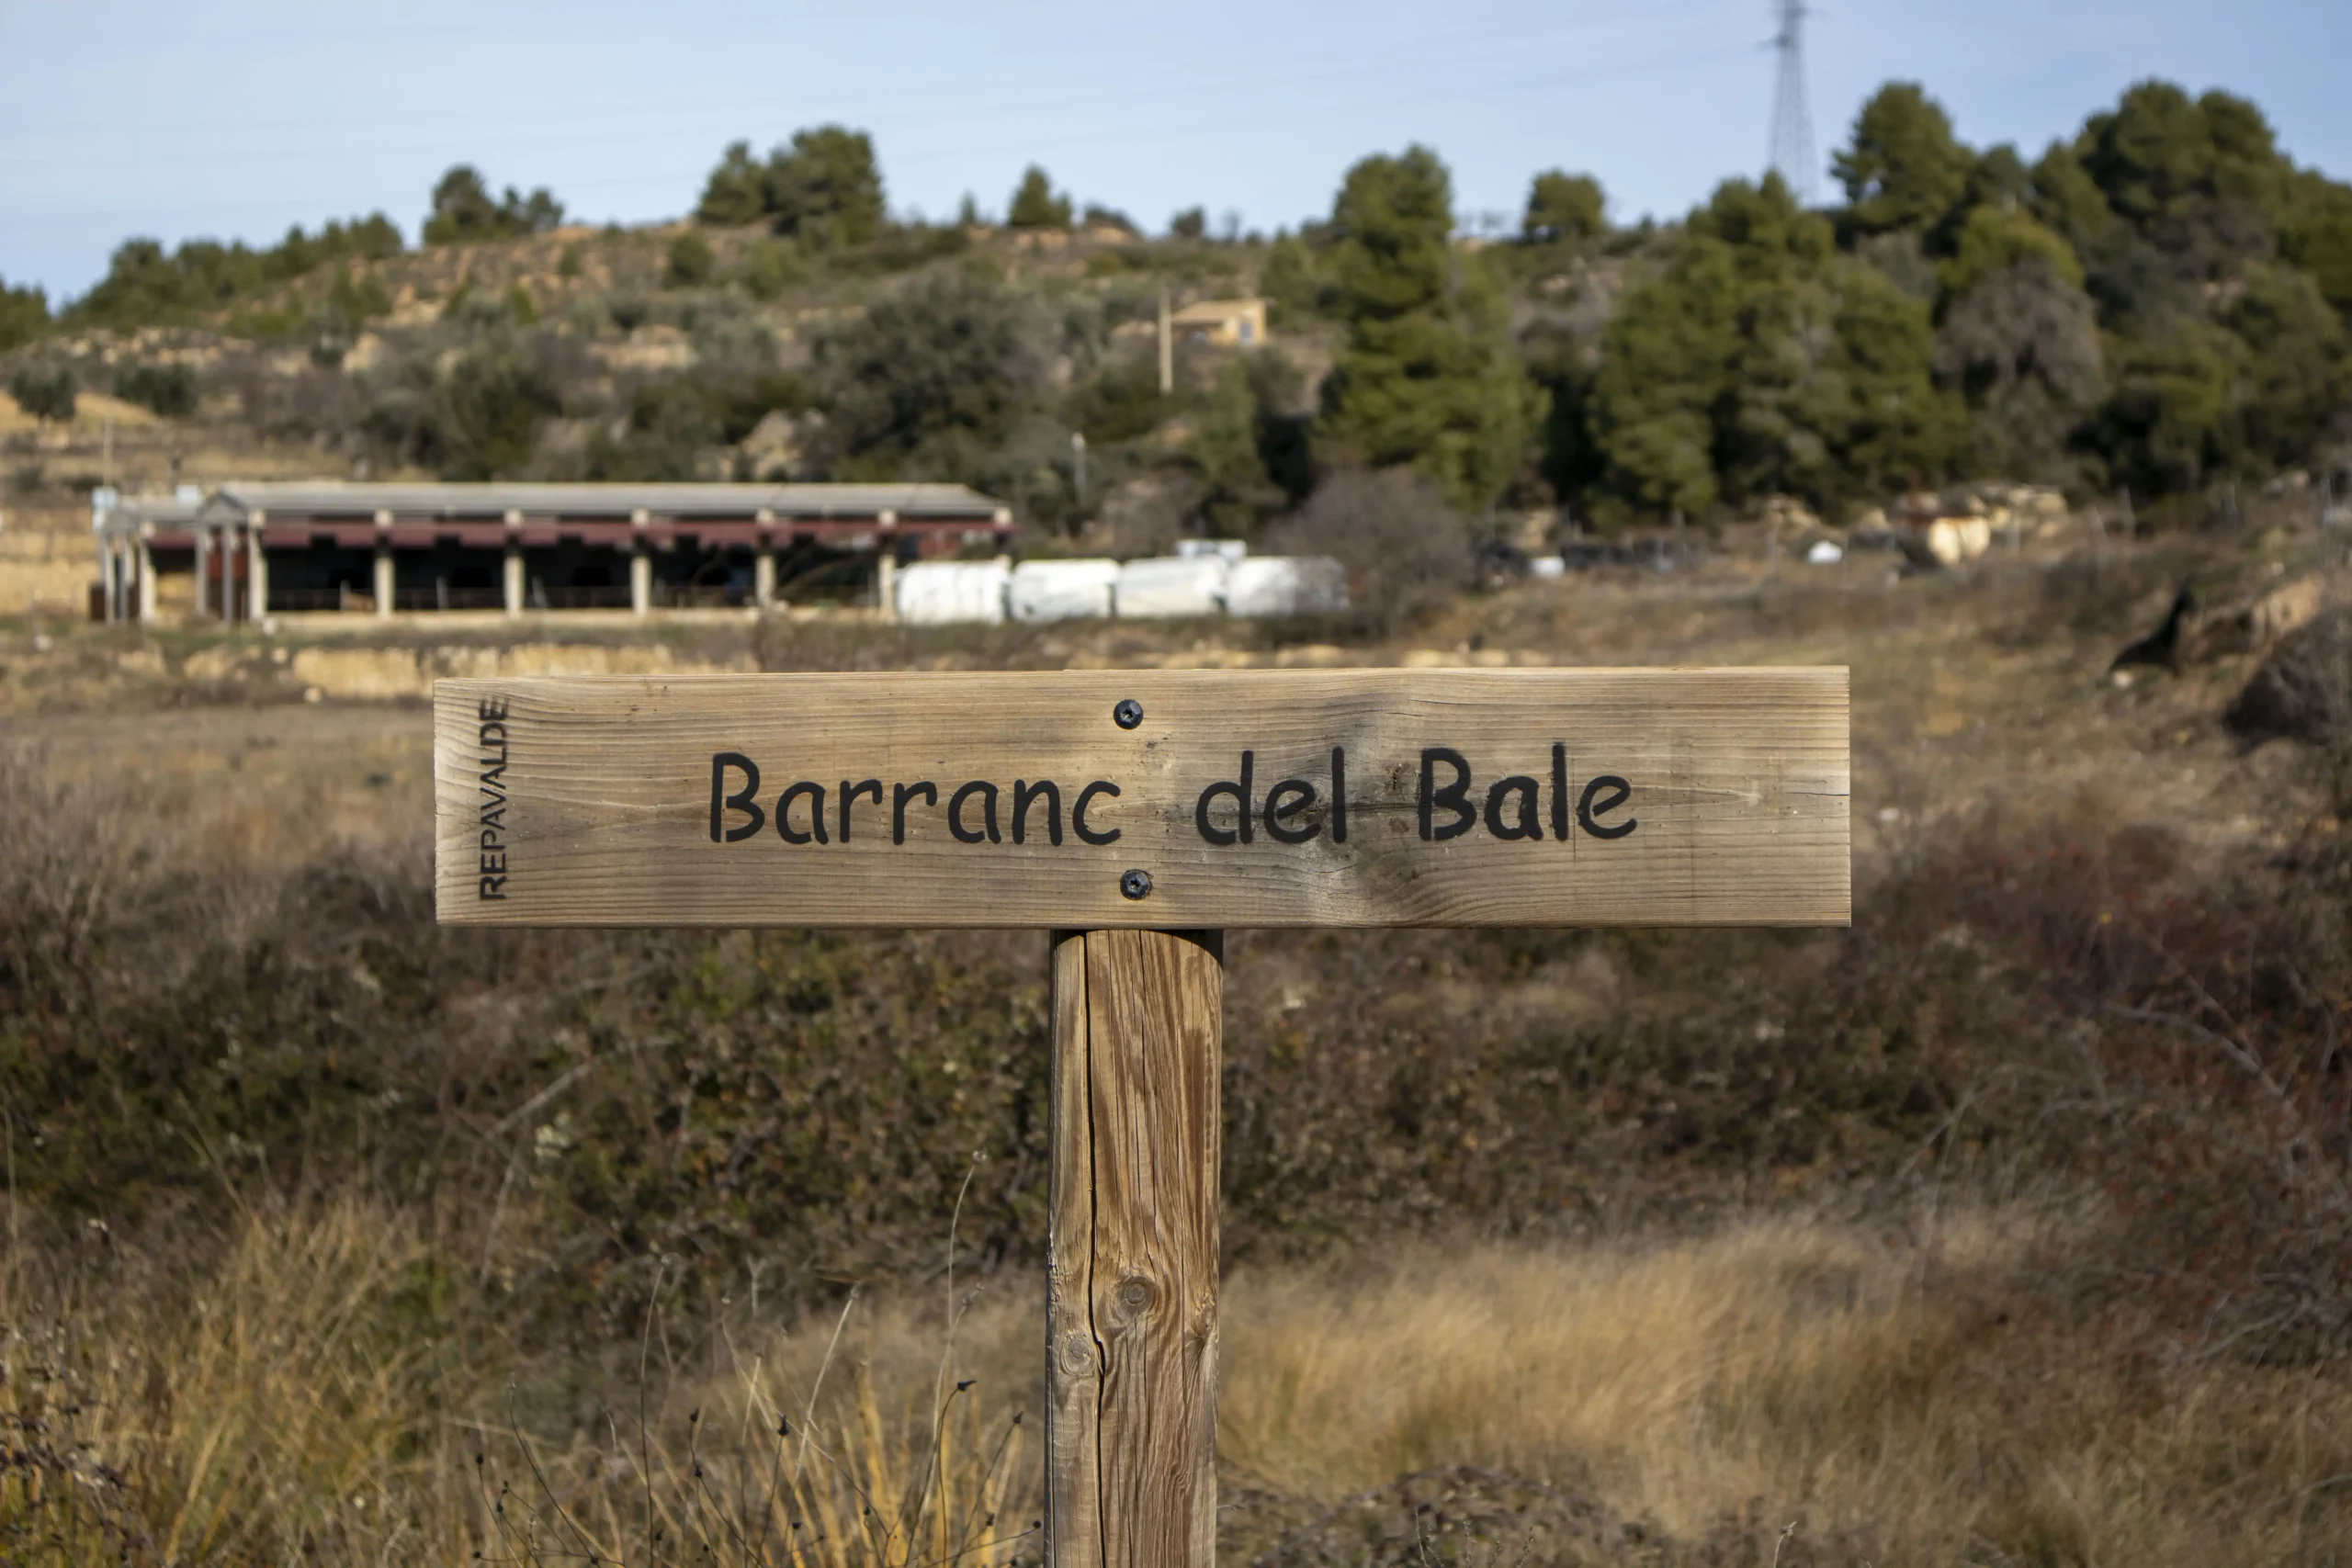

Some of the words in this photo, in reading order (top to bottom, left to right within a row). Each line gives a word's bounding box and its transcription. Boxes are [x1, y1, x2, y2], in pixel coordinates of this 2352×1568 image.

[479, 695, 508, 901] REPAVALDE
[709, 751, 1122, 846] Barranc
[1195, 745, 1348, 845] del
[1418, 740, 1638, 842] Bale
